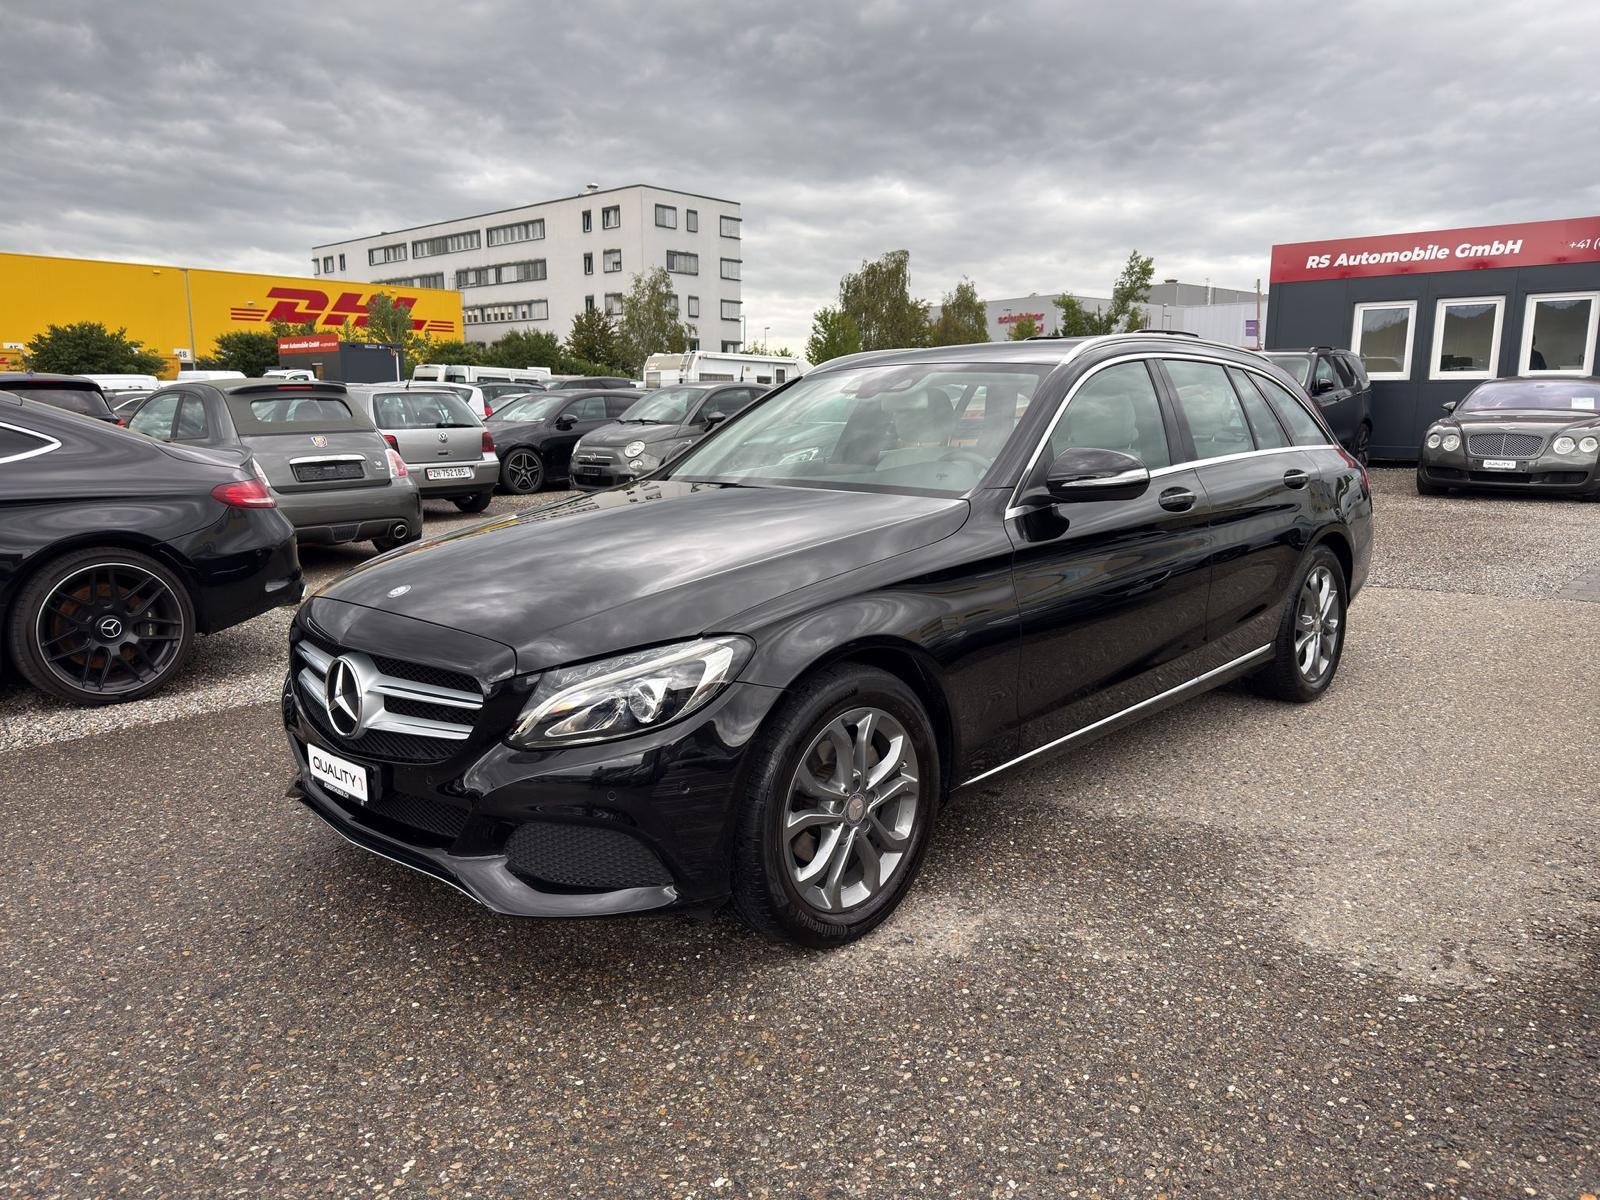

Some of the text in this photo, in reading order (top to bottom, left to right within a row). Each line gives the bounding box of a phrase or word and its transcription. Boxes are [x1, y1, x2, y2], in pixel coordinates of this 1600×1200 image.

[1305, 239, 1523, 269] RS Automobile GmbH
[1568, 238, 1591, 249] +41
[265, 287, 428, 331] DHL
[312, 755, 357, 788] QUALITY
